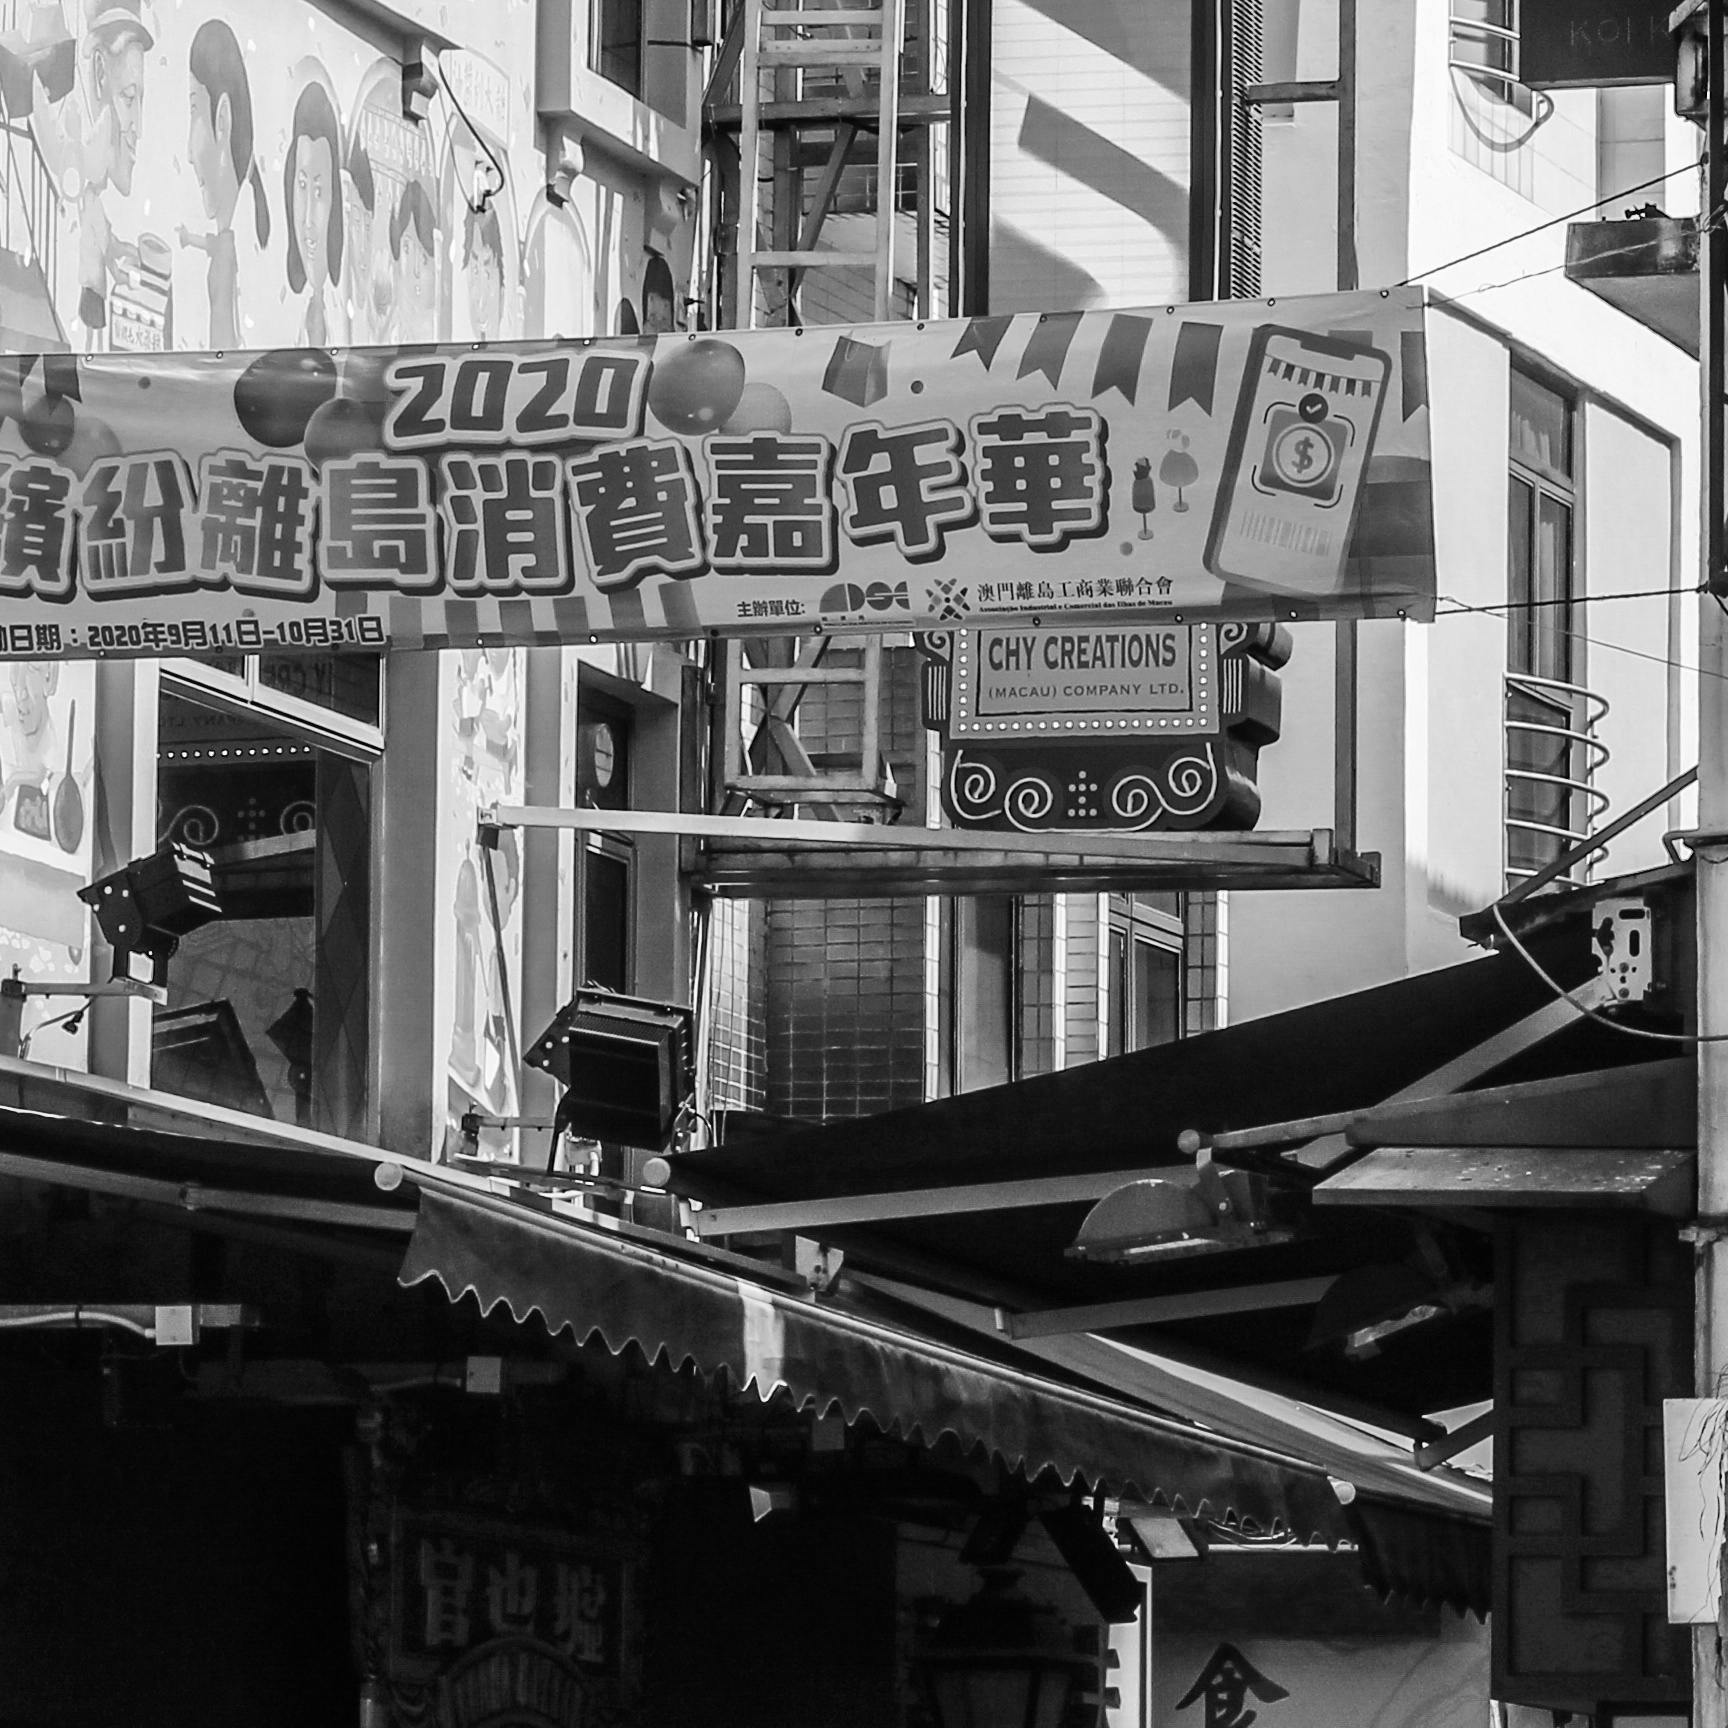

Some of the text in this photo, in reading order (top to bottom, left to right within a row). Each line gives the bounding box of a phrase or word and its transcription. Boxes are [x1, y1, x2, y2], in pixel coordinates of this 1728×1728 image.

[390, 355, 642, 443] 2020
[988, 632, 1176, 671] CHY CREATIONS
[988, 681, 1184, 699] (MACAU) COMPANY LTD.
